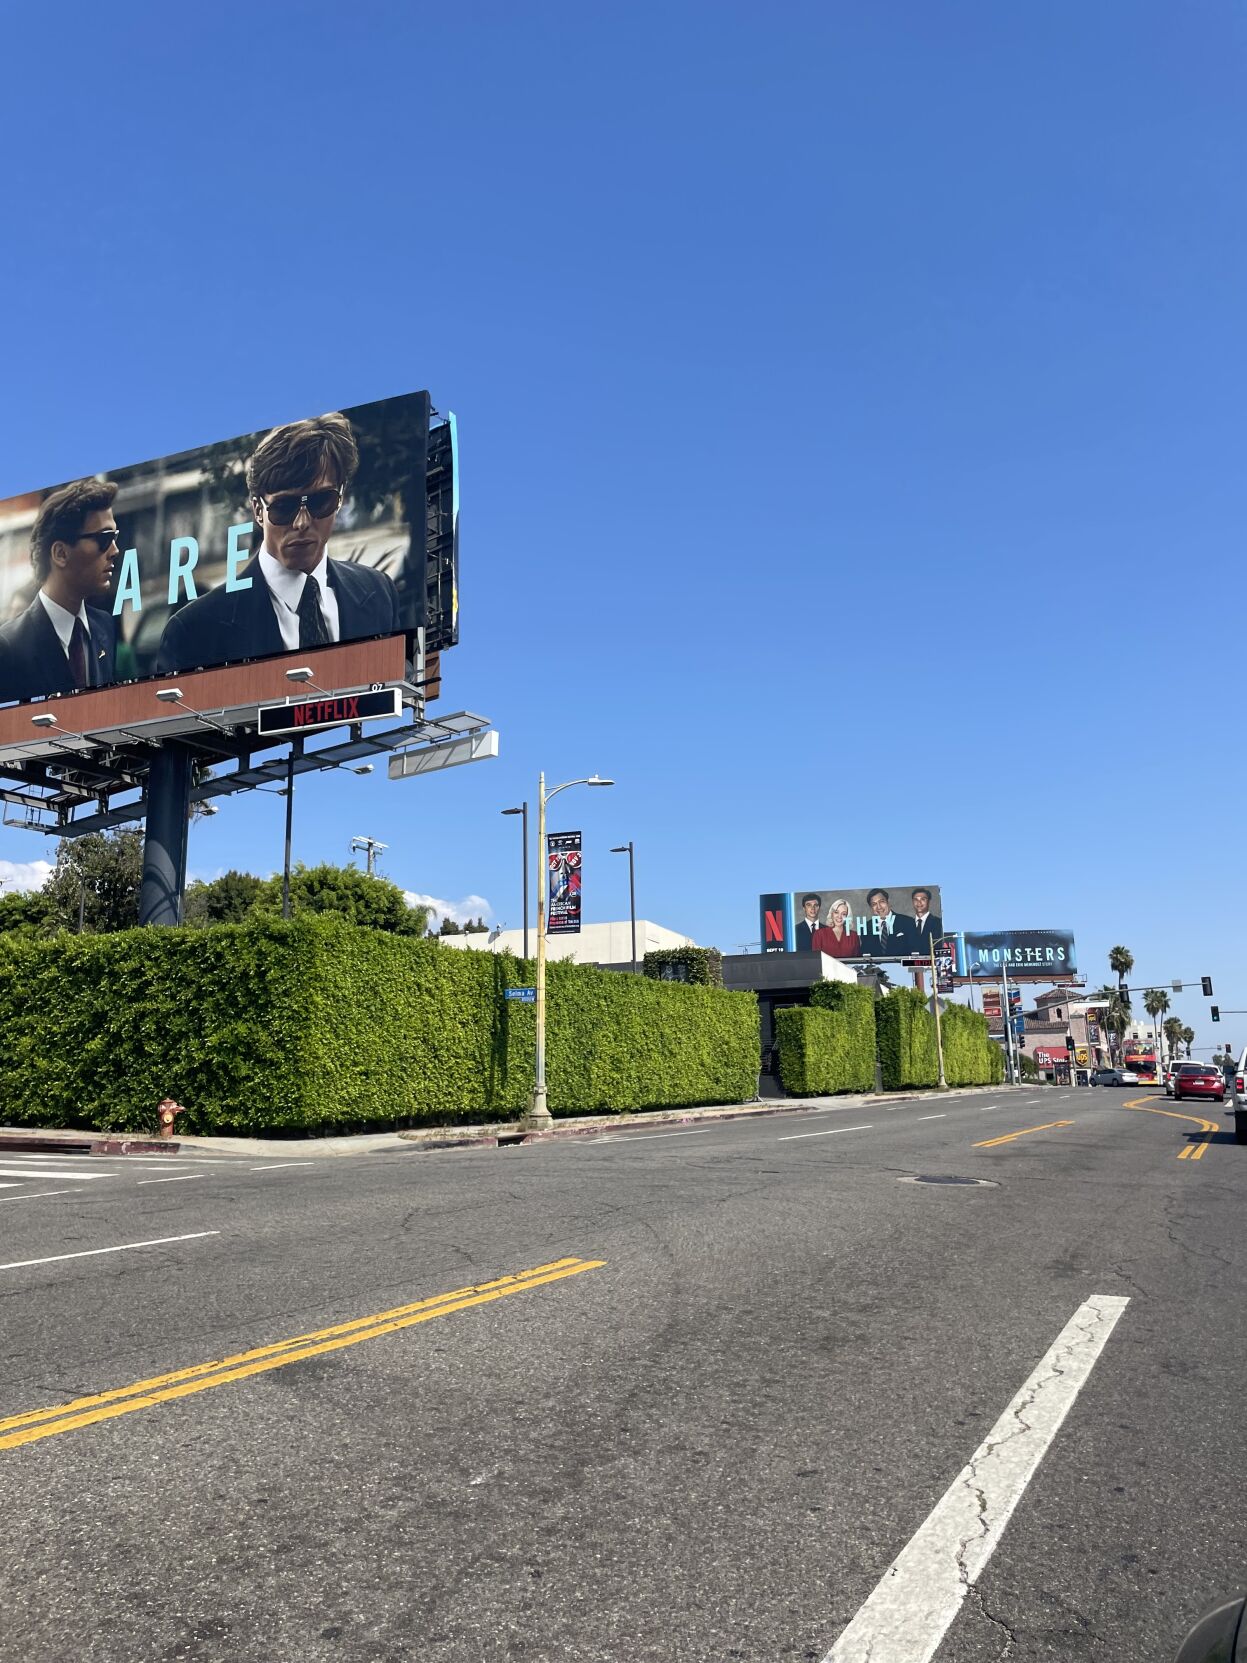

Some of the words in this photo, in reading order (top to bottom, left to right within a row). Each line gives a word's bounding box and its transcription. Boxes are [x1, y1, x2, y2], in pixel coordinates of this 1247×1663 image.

[113, 521, 254, 616] ARE
[294, 697, 359, 727] NETFLIX
[765, 911, 784, 942] N
[844, 914, 896, 937] THEY
[978, 946, 1066, 963] MONSTERS
